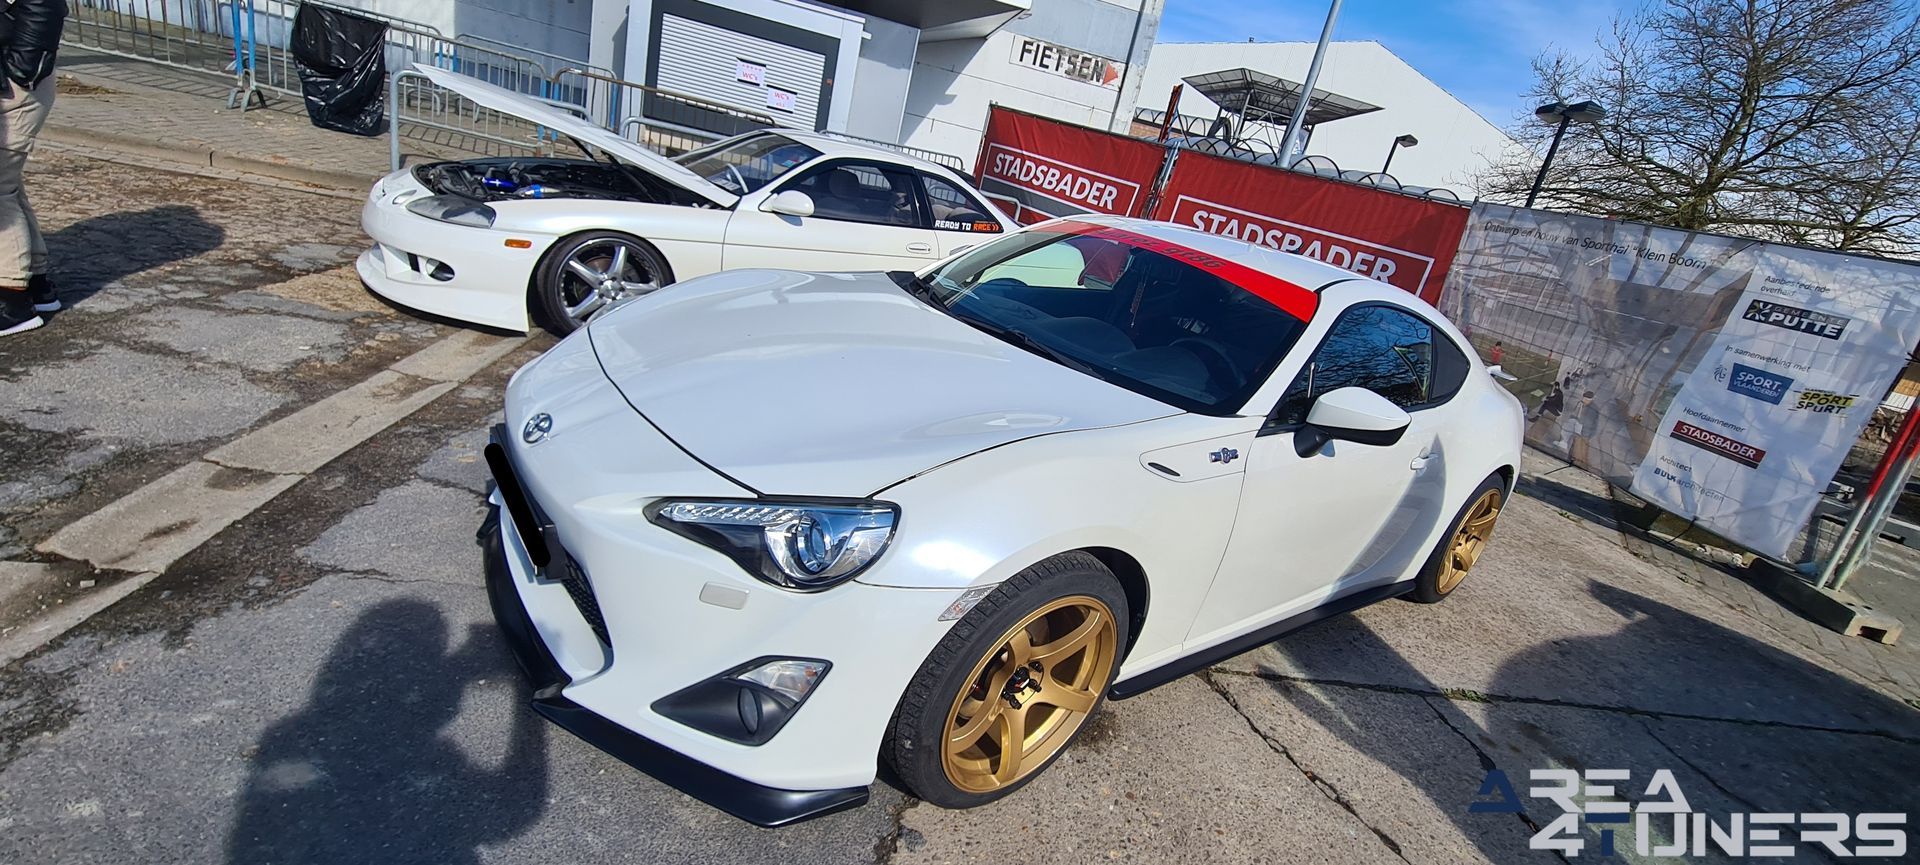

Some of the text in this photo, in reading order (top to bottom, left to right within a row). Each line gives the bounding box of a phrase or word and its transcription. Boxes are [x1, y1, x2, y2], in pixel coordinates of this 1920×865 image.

[1019, 40, 1103, 82] FIETSEN
[993, 153, 1117, 211] STADSBADER
[934, 219, 960, 230] READY
[961, 222, 972, 231] TO
[973, 223, 991, 231] RACE
[1484, 221, 1519, 236] Ontwerp
[1562, 236, 1579, 246] van
[1581, 237, 1630, 256] Sporthal
[1768, 312, 1841, 337] PUTTE
[1725, 344, 1733, 352] In
[1734, 348, 1792, 369] samenwerking
[1733, 381, 1780, 398] VLAANDEREN
[1683, 407, 1746, 433] Hoofdaannemer
[1680, 425, 1757, 459] STADSBADER
[1660, 455, 1692, 472] Architect
